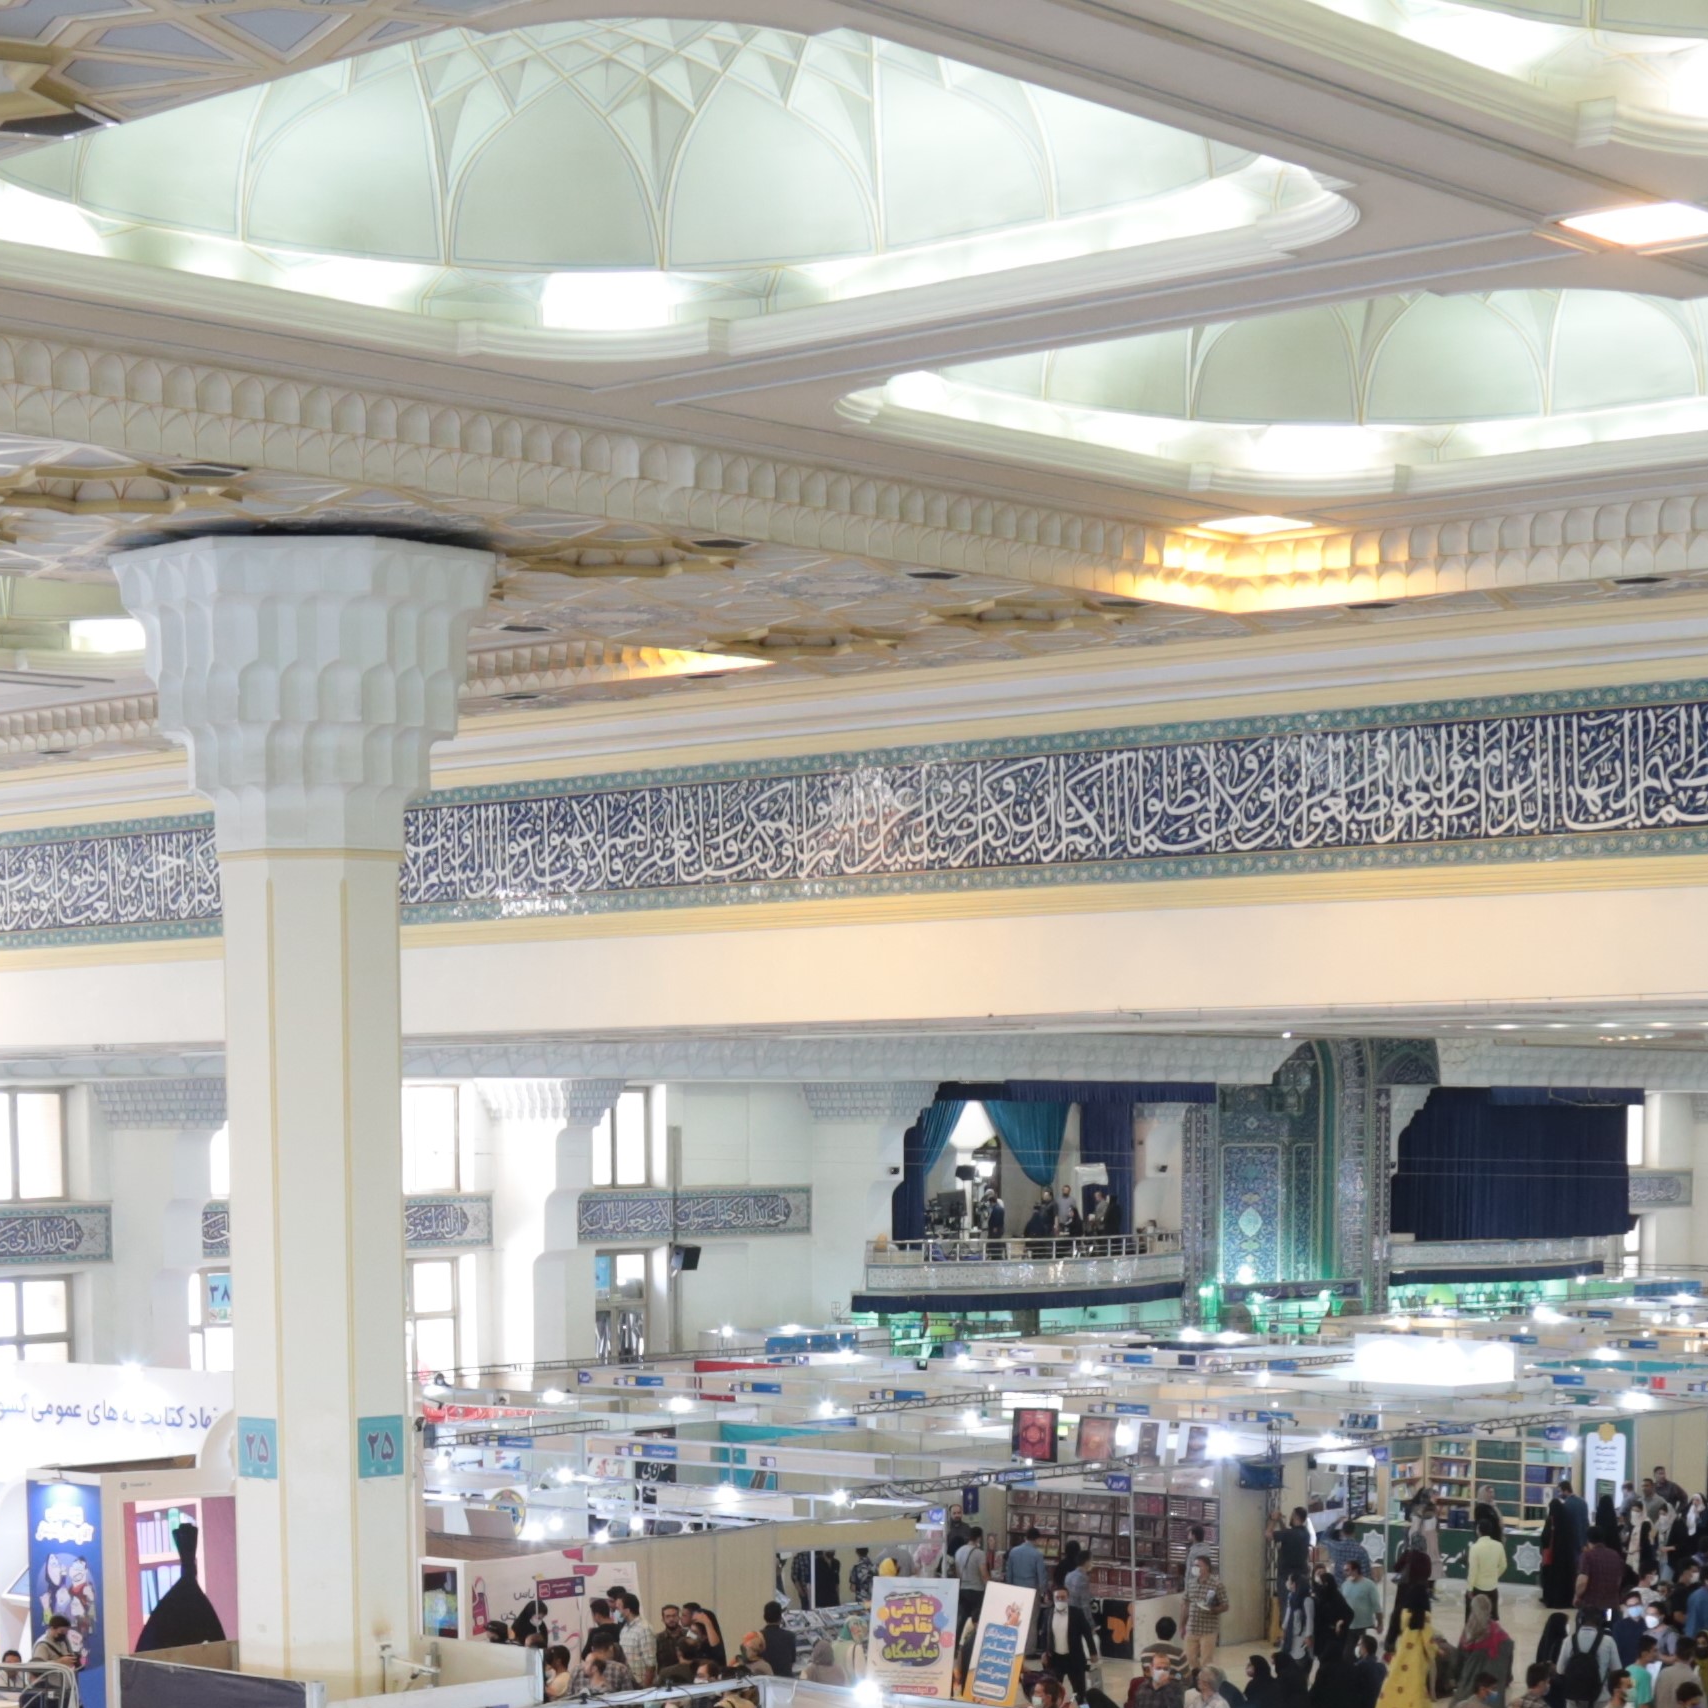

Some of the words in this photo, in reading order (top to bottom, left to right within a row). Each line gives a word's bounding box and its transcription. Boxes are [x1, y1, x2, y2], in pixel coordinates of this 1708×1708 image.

[366, 1432, 395, 1462] ۲۵
[891, 1597, 935, 1619] نقاشی
[889, 1616, 933, 1637] نقاشی
[883, 1638, 940, 1661] نمایشگاه
